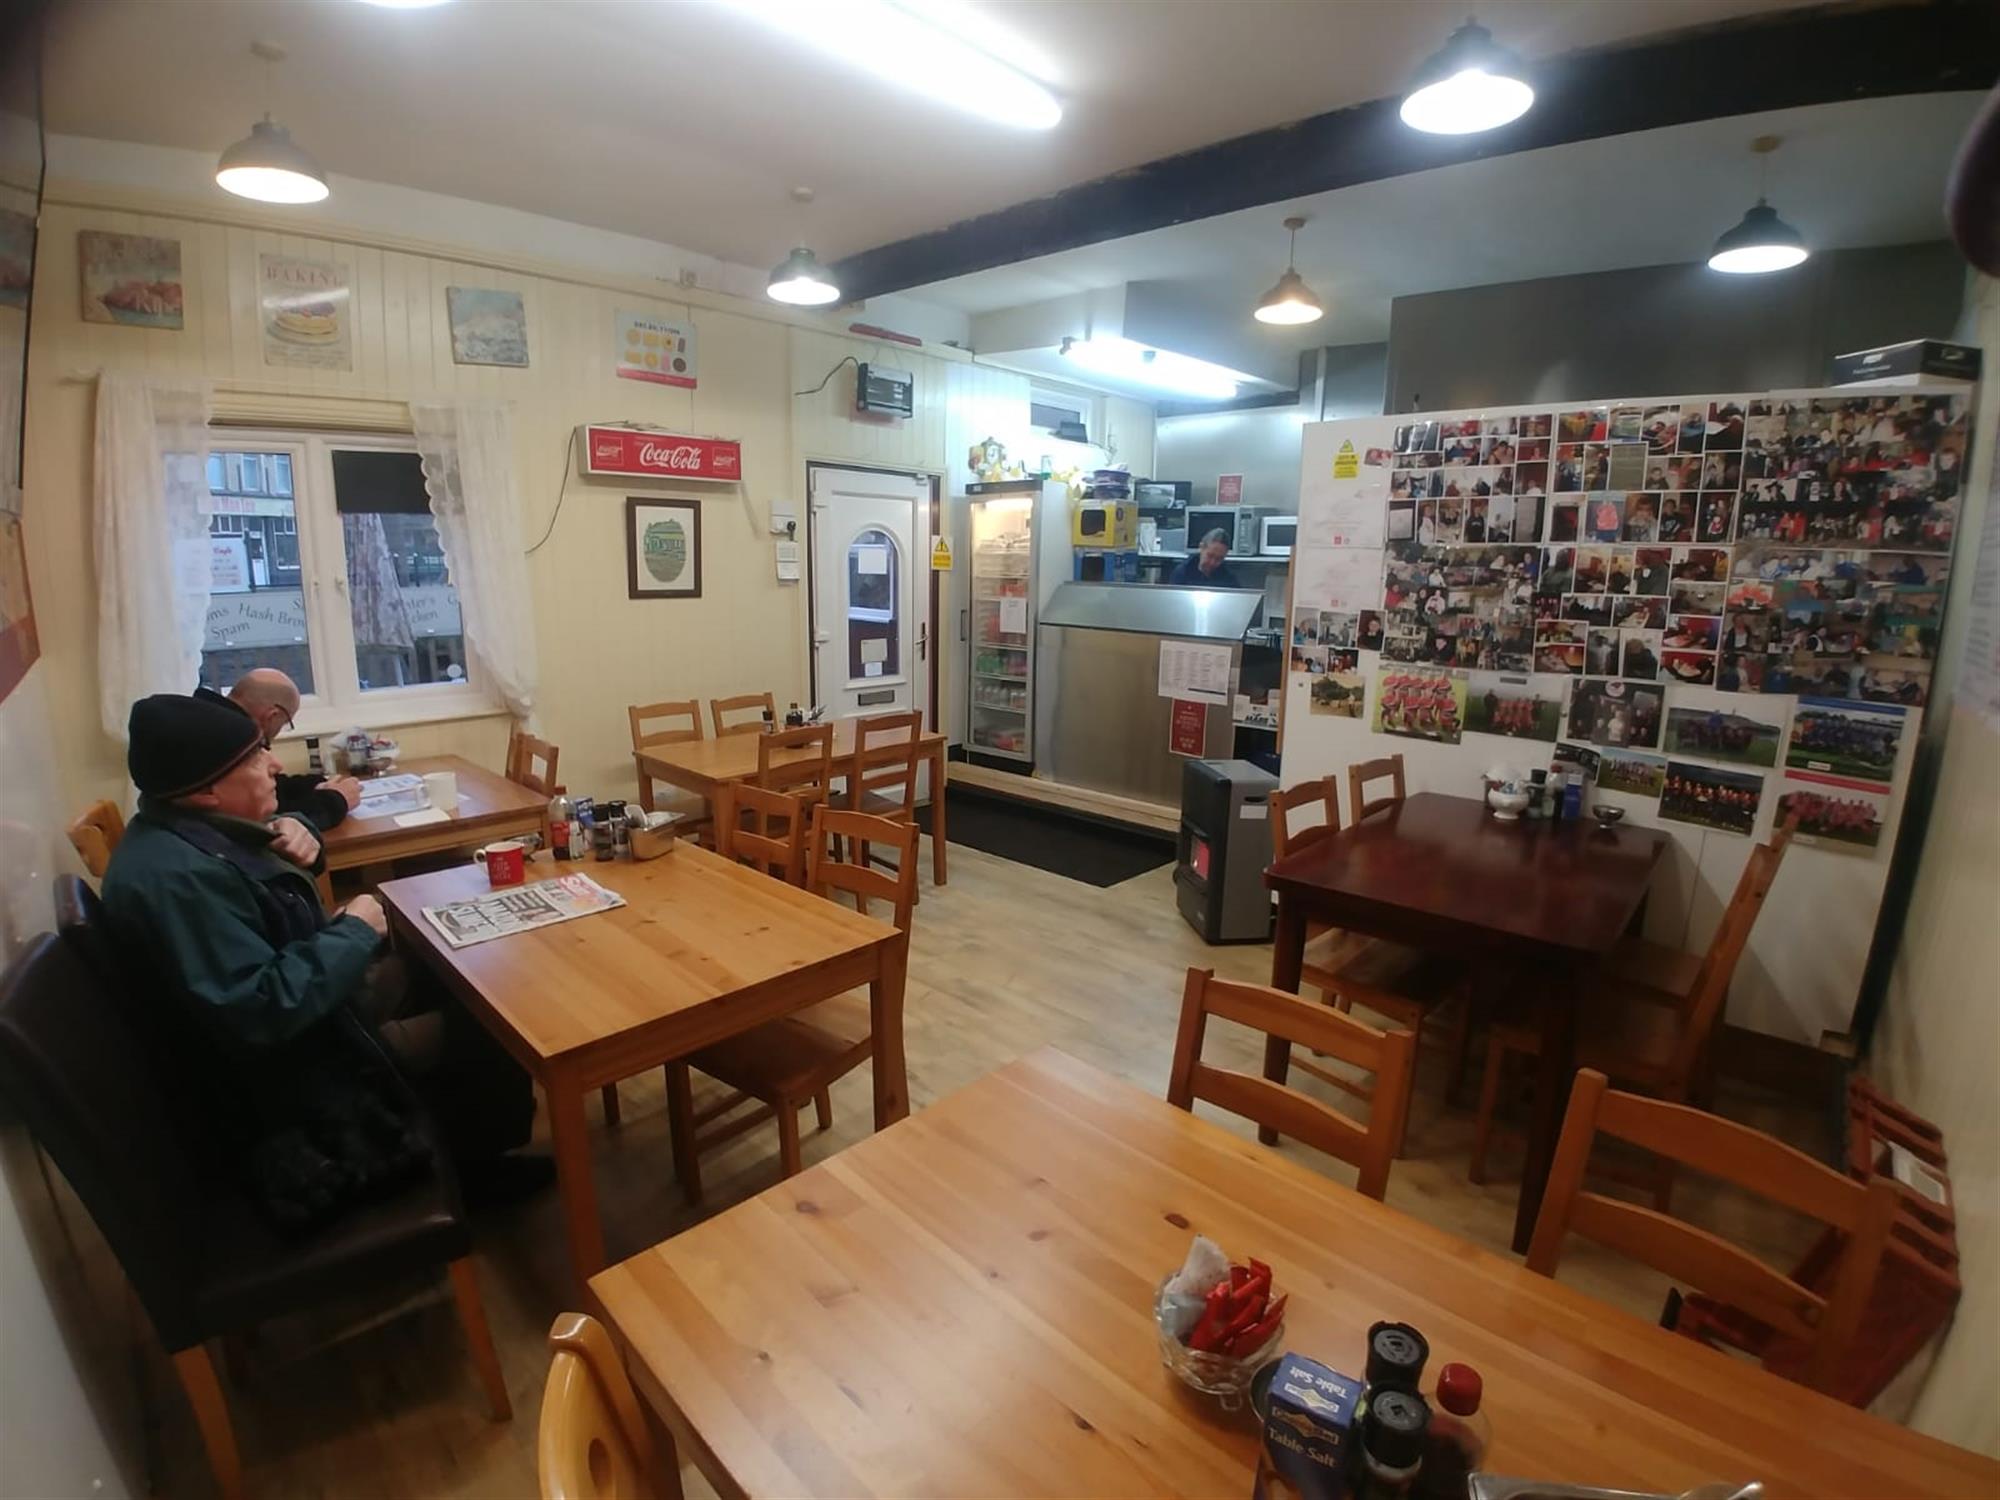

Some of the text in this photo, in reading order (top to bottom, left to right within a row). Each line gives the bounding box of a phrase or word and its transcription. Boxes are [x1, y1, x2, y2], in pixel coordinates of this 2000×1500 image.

[639, 442, 702, 470] Coca-Cola
[239, 602, 275, 622] Hash
[209, 621, 251, 641] Spam
[1289, 1365, 1314, 1384] Salt
[1315, 1376, 1348, 1399] Table
[1268, 1424, 1305, 1453] Table
[1307, 1446, 1337, 1468] Salt
